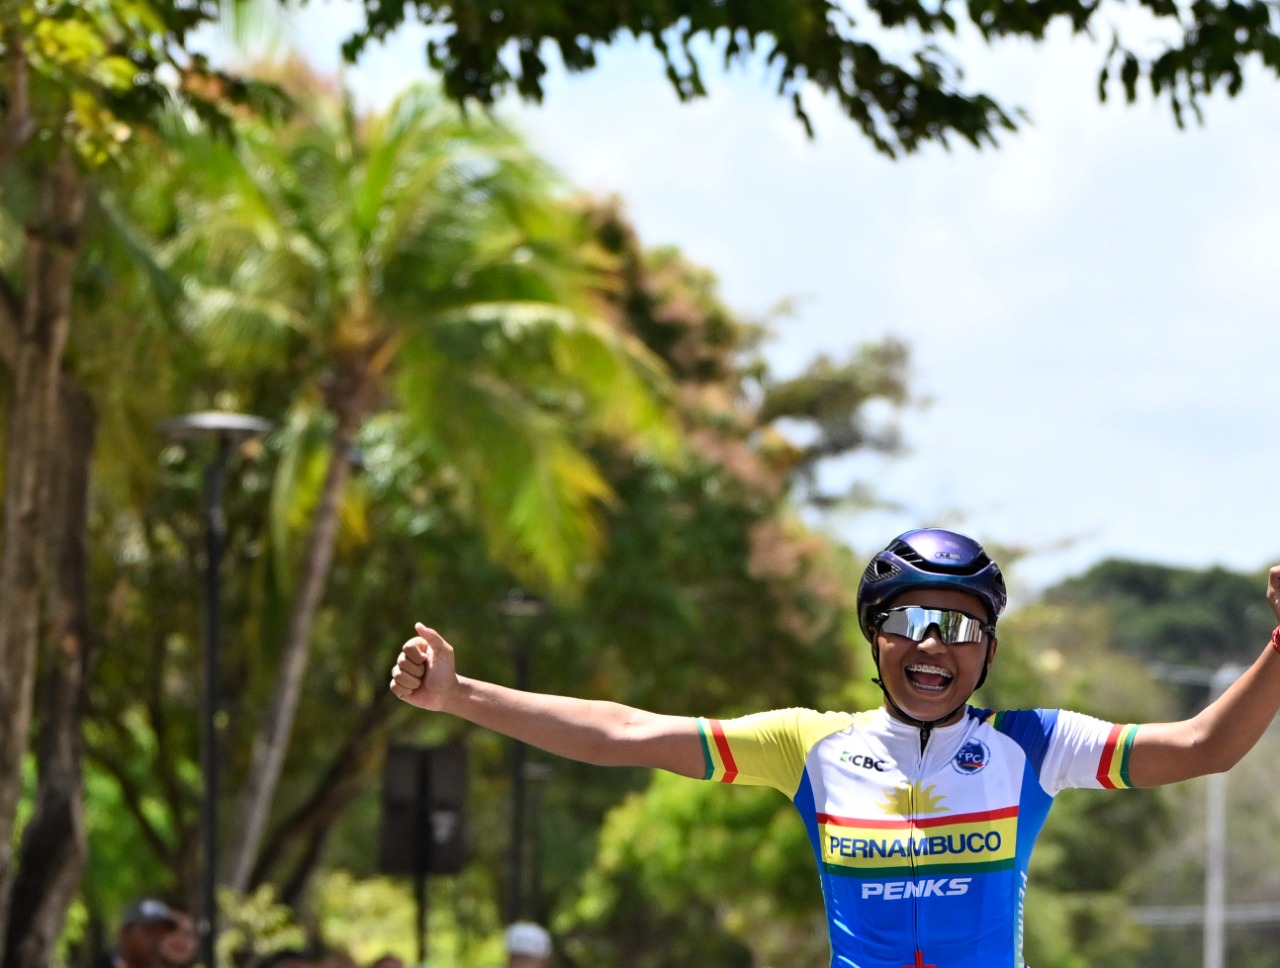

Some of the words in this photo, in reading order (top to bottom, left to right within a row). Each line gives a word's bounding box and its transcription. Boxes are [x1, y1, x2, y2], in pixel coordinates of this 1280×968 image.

[852, 754, 885, 772] CBC
[829, 830, 1001, 859] PERNAMBUCO
[861, 876, 972, 901] PENKS
